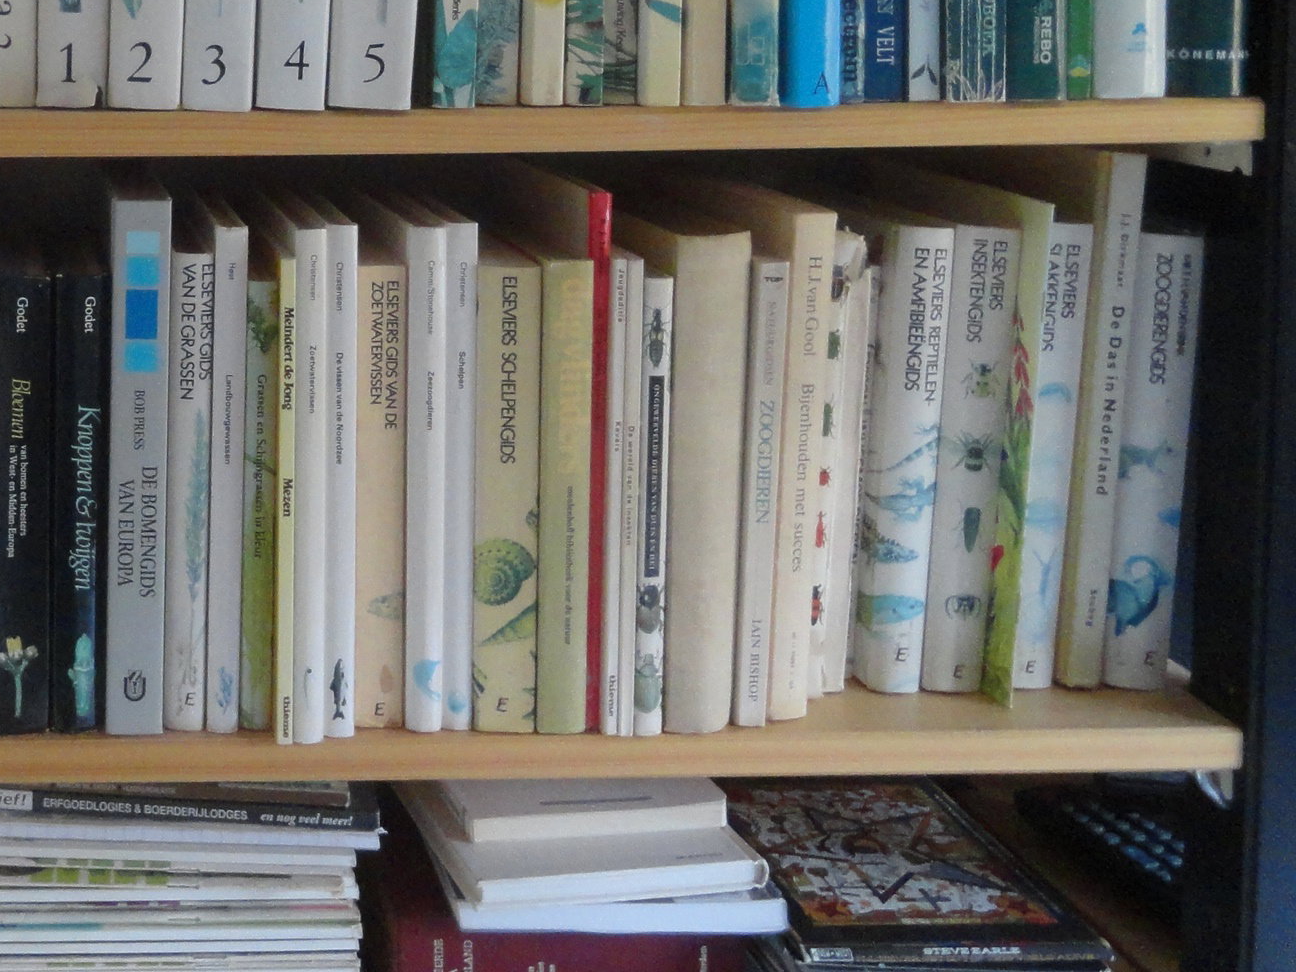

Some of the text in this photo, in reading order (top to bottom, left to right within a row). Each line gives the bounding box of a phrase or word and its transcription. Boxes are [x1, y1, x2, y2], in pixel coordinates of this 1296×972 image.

[58, 44, 78, 84] 1
[127, 42, 153, 83] 2
[201, 44, 226, 85] 3
[284, 41, 310, 82] 4
[362, 42, 386, 83] 5
[876, 26, 894, 64] VELT
[1040, 16, 1052, 64] REBO
[180, 263, 196, 401] VAN DE GRASSEN
[905, 247, 930, 392] EN AMFIBIEËNGIDS
[925, 248, 947, 407] ELSEVIERS REPTIELEN-
[966, 238, 988, 343] INSEKTENGIDS
[990, 240, 1008, 311] ELSEVIERS
[1062, 244, 1081, 319] ELSEVIERS
[1149, 252, 1172, 385] ZOOGDIERENGIDS
[10, 296, 32, 438] Godet Bloemen
[370, 281, 384, 405] ZOETWATERVISSEN
[385, 280, 400, 430] ELSEVIERS GIDS VAN DE
[499, 276, 518, 464] ELSEVIERS SCHELPENGIDS
[1097, 306, 1125, 495] De Das in Nederland
[68, 295, 101, 591] Godet Knoppen & twijgen
[134, 389, 146, 451] BOB PRESS
[118, 480, 136, 587] VAN EUROPA
[139, 466, 158, 598] DE BOMENGIDS
[749, 399, 775, 703] ZOOGDIEREN IAIN BISHOP
